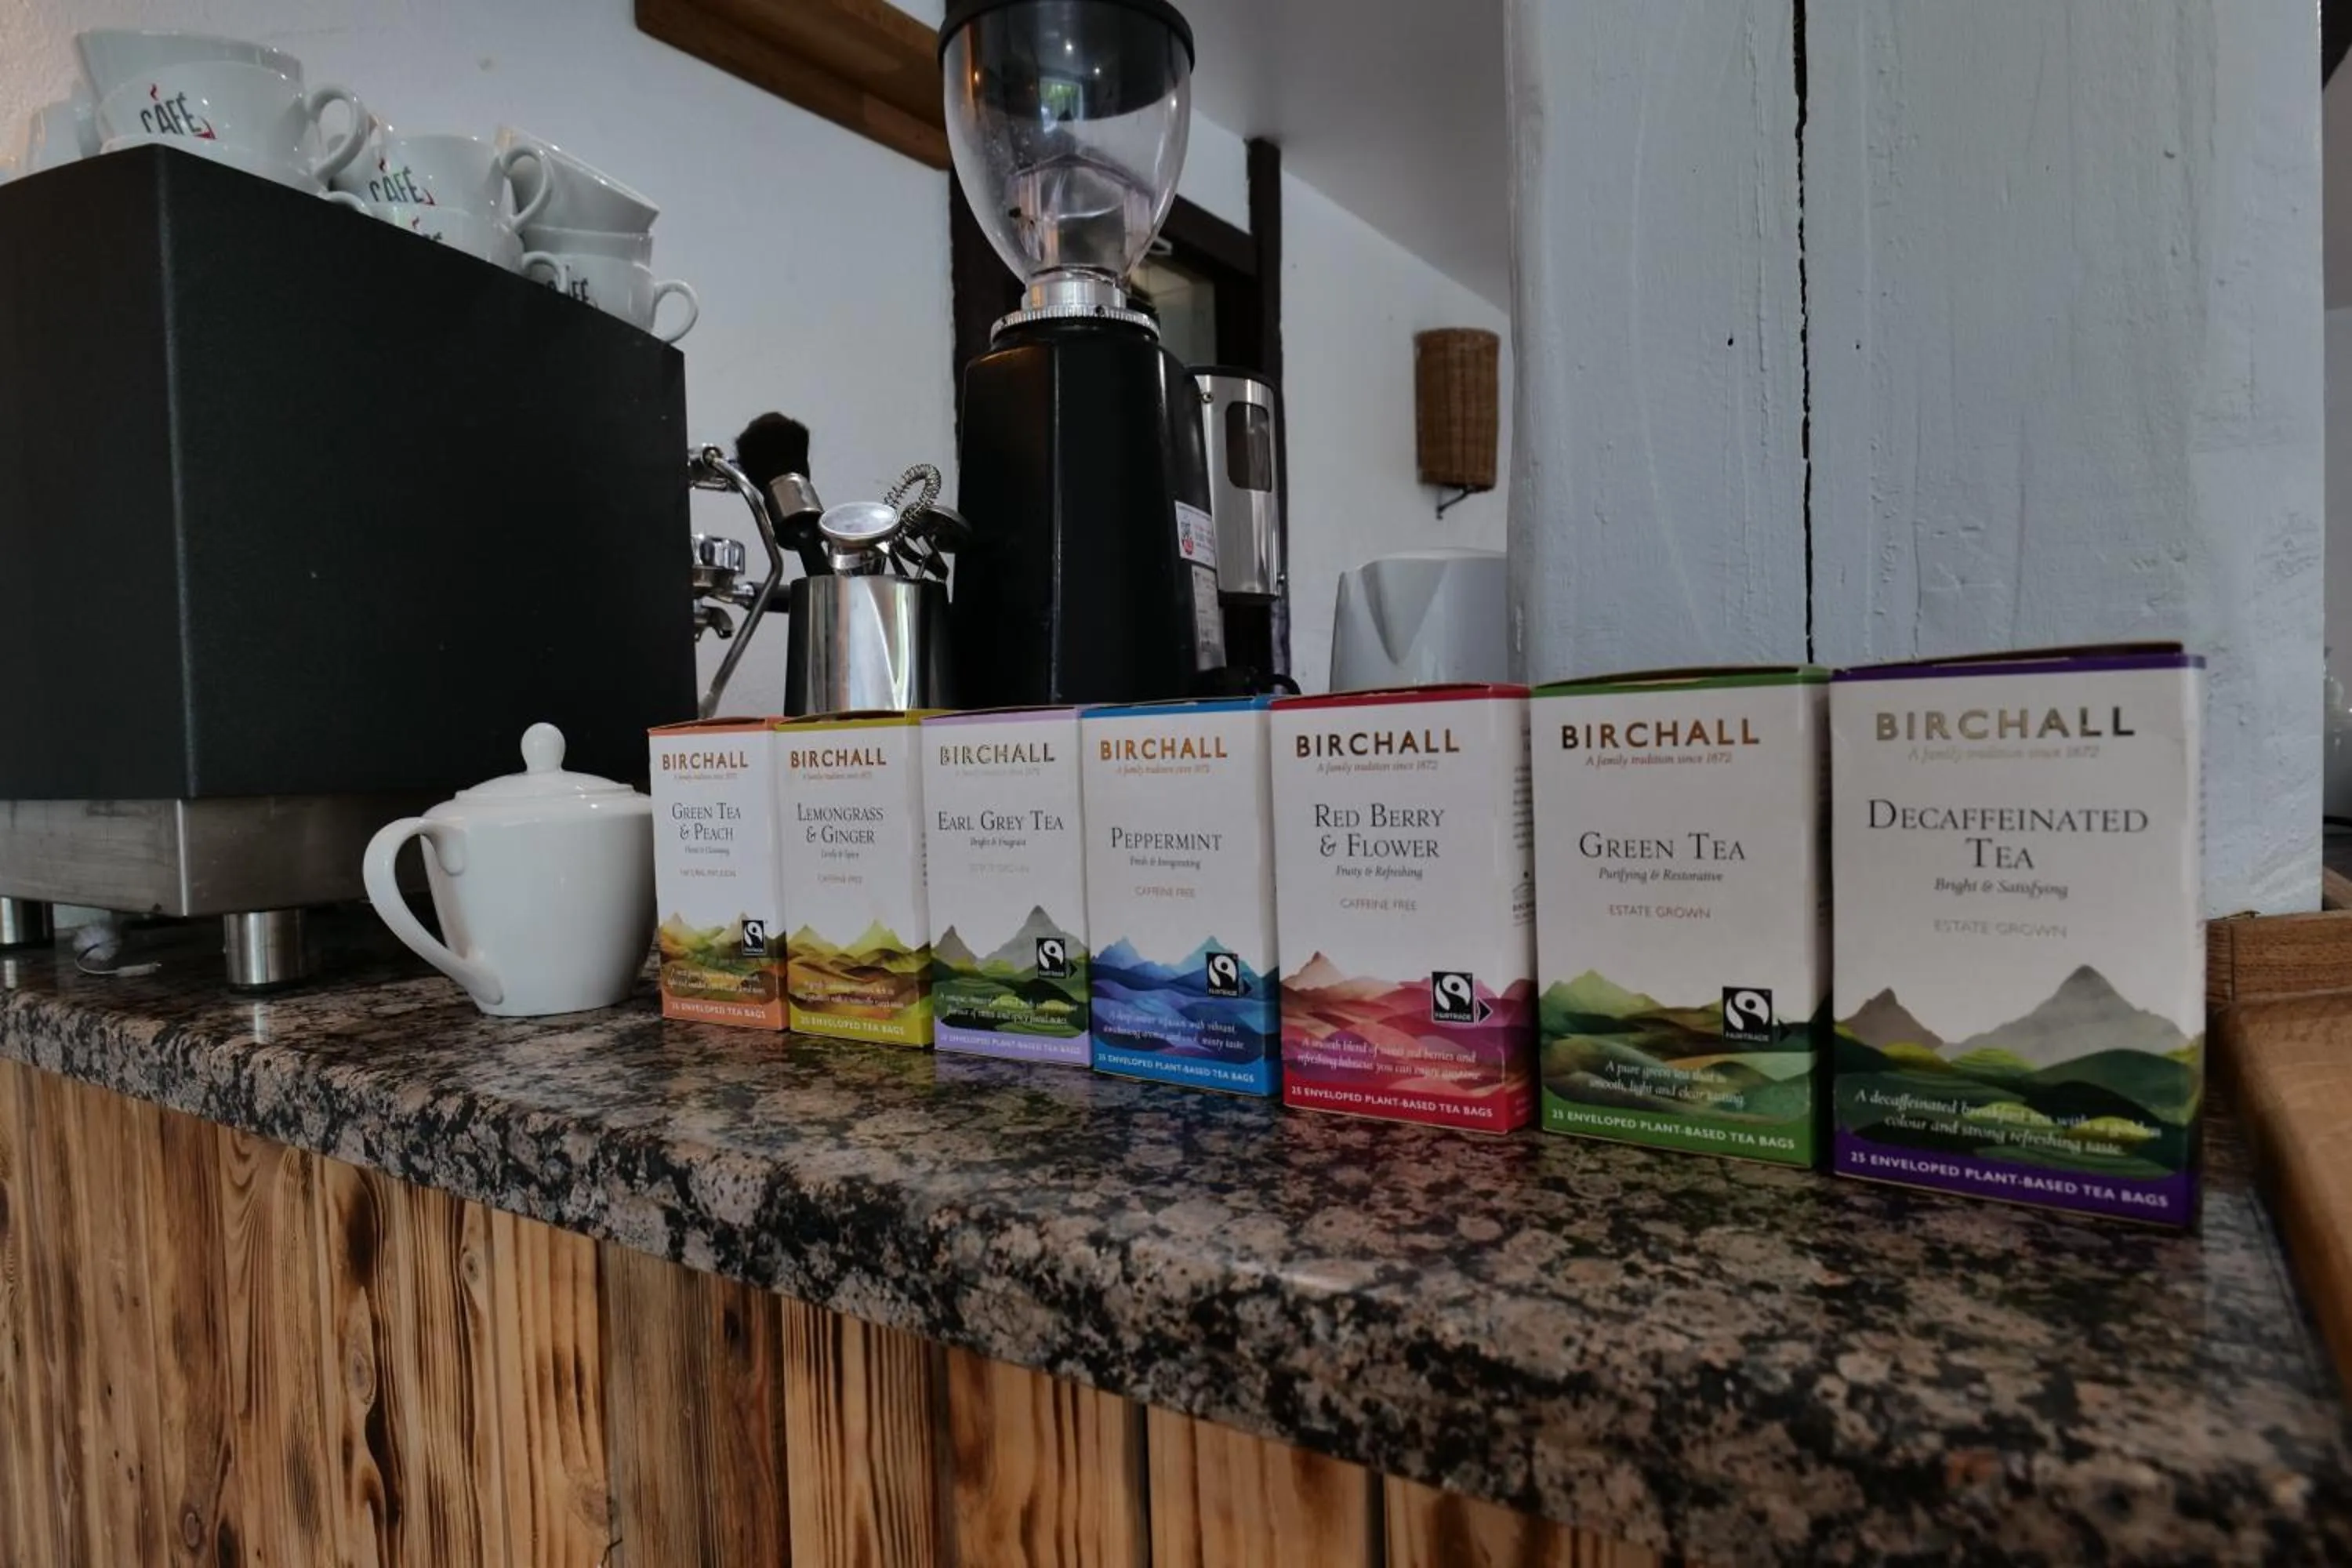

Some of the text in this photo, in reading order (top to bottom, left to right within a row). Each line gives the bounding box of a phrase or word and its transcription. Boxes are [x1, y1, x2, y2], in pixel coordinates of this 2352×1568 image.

[1561, 718, 1760, 750] BIRCHALL
[1876, 706, 2136, 741] BIRCHALL
[940, 742, 1055, 765] BIRCHALL
[1100, 735, 1228, 760] BIRCHALL
[1296, 728, 1460, 757] BIRCHALL
[662, 750, 750, 771] BIRCHALL
[790, 747, 887, 768] BIRCHALL
[1585, 751, 1732, 768] A family tradition since 1872
[1921, 747, 1961, 764] family
[1326, 762, 1352, 775] family
[672, 802, 741, 820] GREEN TEA
[797, 802, 884, 822] LEMONGRASS
[938, 810, 1064, 831] EARL GREY TEA
[1315, 803, 1445, 828] RED BERRY
[1867, 798, 2149, 833] DECAFFEINATED
[680, 823, 734, 840] & PEACH
[806, 824, 875, 844] & GINGER
[1111, 826, 1222, 851] PEPPERMINT
[1319, 833, 1440, 858] & FLOWER
[1579, 831, 1745, 860] GREEN TEA
[1965, 837, 2035, 869] TEA
[1336, 865, 1362, 878] Fruity
[1374, 866, 1423, 880] Refreshing
[1599, 866, 1723, 884] Purifying & Restorative
[1934, 877, 2069, 900] Bright & Satisfying
[1339, 898, 1417, 911] CAFFEINE FREE
[1609, 905, 1711, 919] ESTATE GROWN
[1933, 919, 2067, 938] ESTATE GROWN
[728, 1007, 742, 1016] TEA
[745, 1008, 766, 1018] BAGS
[863, 1022, 879, 1032] TEA
[882, 1025, 905, 1036] BAGS
[1343, 1040, 1367, 1053] blend
[1425, 1047, 1454, 1062] berries
[1457, 1050, 1476, 1063] and
[1108, 1054, 1153, 1068] ENVELOPED
[1155, 1060, 1210, 1076] PLANT-BASED
[1213, 1069, 1229, 1080] TEA
[1232, 1071, 1254, 1083] BAGS
[1605, 1060, 1614, 1072] A
[1617, 1063, 1640, 1077] pure
[1655, 1084, 1676, 1096] and
[1855, 1088, 1867, 1103] A
[1869, 1090, 1958, 1114] decaffeinated
[1305, 1087, 1363, 1103] ENVELOPED
[1365, 1094, 1436, 1112] PLANT-BASED
[1439, 1103, 1461, 1115] TEA
[1464, 1105, 1493, 1117] BAGS
[1552, 1109, 1795, 1149] 25 ENVELOPED PLANT-BASED TEA BAGS
[1883, 1114, 1928, 1130] colour
[1930, 1120, 1958, 1135] and
[1962, 1125, 2005, 1145] strong
[2009, 1130, 2082, 1154] refreshing
[1850, 1151, 2169, 1208] 25 ENVELOPED PLANT-BASED TEA BAGS
